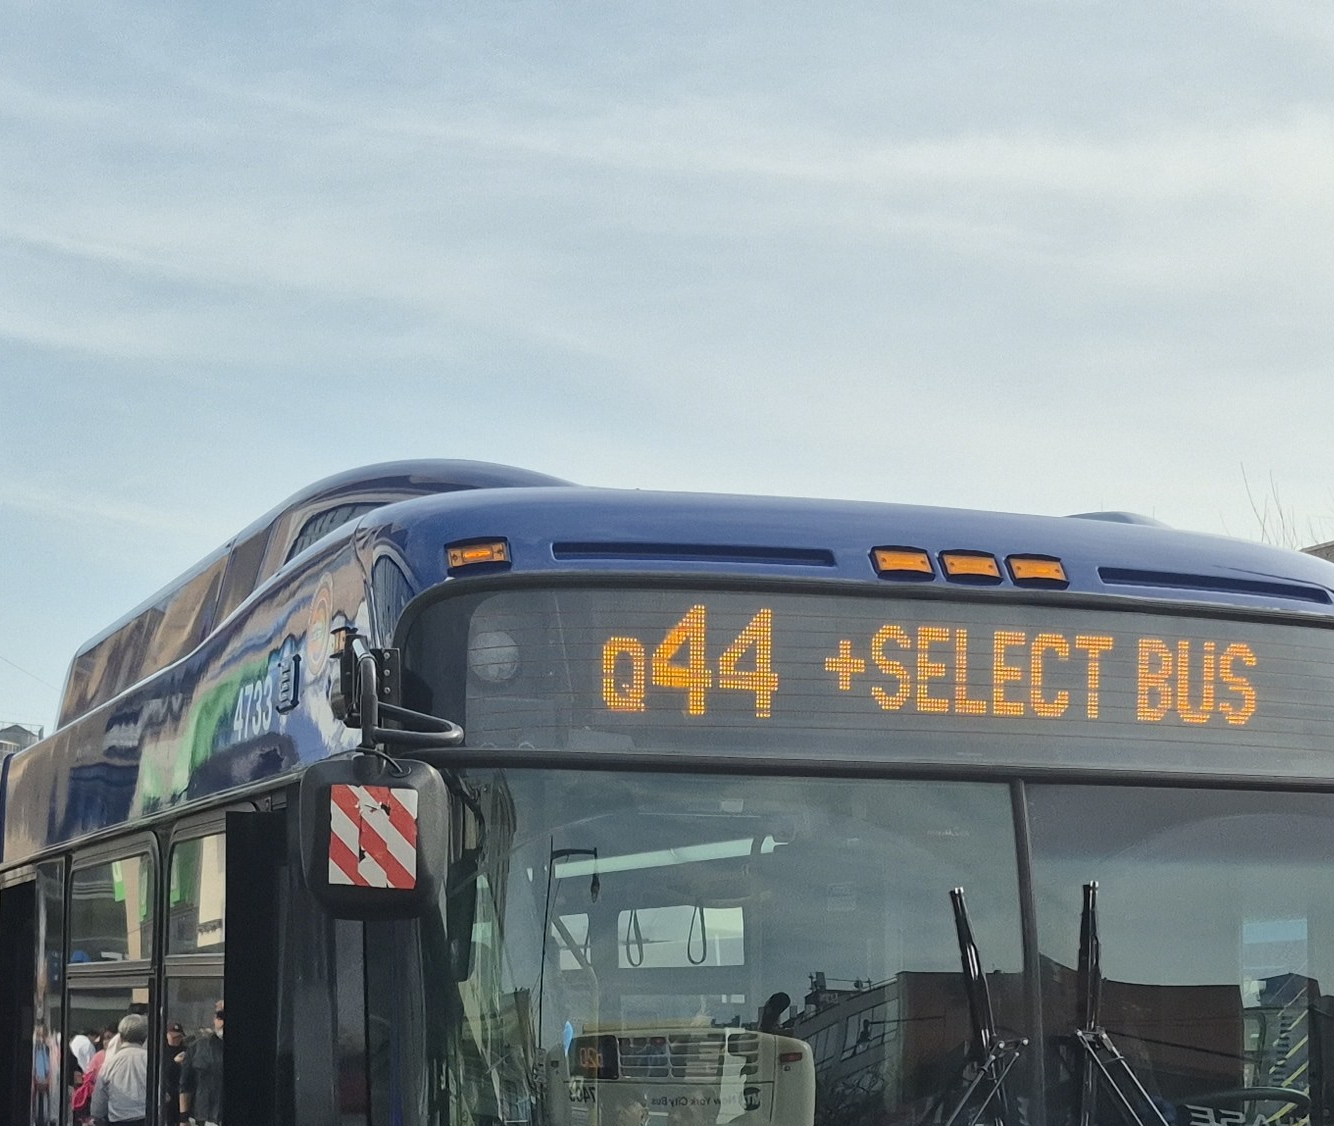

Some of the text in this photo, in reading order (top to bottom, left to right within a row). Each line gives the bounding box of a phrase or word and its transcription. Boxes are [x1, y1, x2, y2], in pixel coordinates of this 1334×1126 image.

[234, 675, 272, 741] 4733
[601, 604, 1258, 726] Q44 +SELECT BUS
